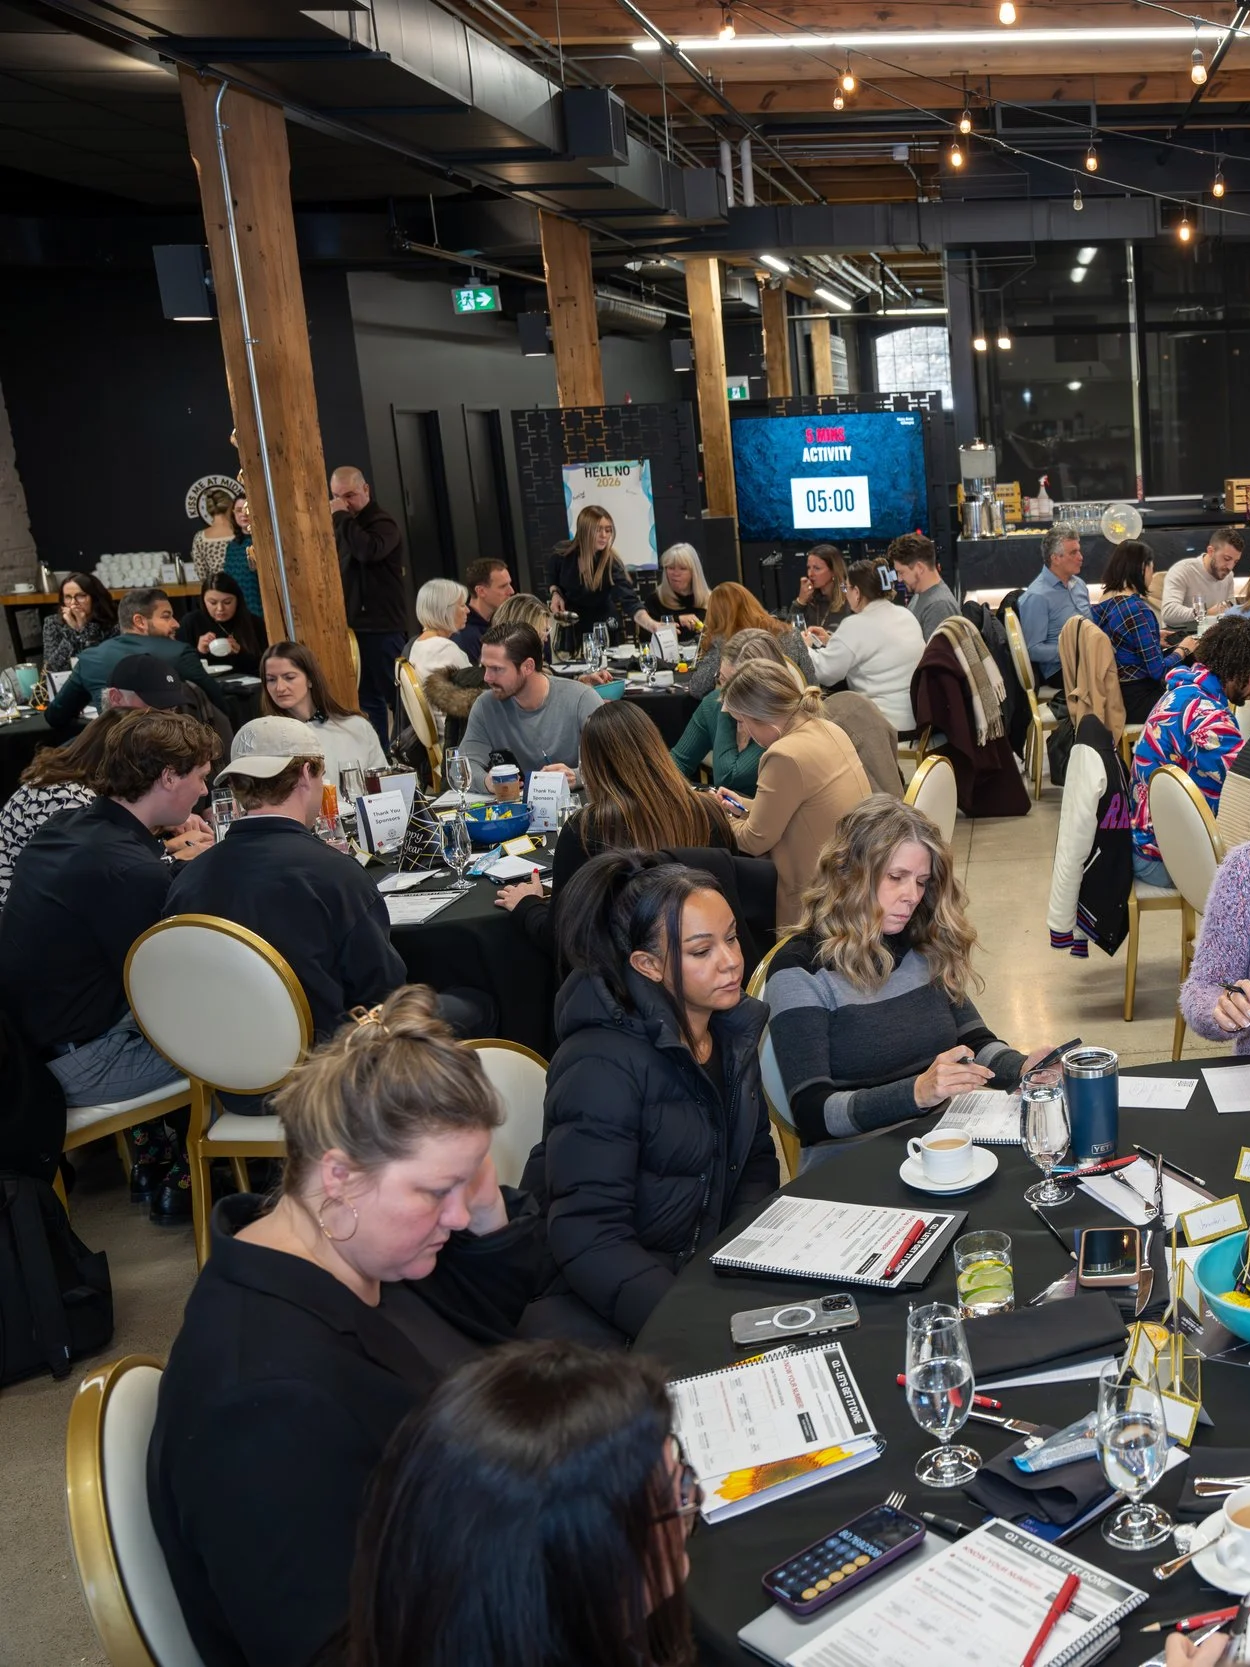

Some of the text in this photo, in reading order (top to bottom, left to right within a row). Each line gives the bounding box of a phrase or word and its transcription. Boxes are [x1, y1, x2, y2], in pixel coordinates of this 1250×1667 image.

[805, 427, 846, 443] 5 MINS
[802, 446, 852, 462] ACTIVITY
[584, 465, 630, 478] HELL NO
[596, 477, 621, 487] 2026
[188, 495, 196, 516] KISS
[192, 482, 205, 494] ME
[207, 477, 217, 485] AT
[806, 488, 855, 513] 05:00
[834, 1370, 850, 1388] LET'S
[840, 1385, 855, 1400] GET
[845, 1398, 857, 1407] IT
[848, 1405, 863, 1424] DONE
[1003, 1530, 1018, 1543] Q1
[1021, 1539, 1051, 1559] LET'S
[1047, 1553, 1069, 1569] GET
[1079, 1569, 1111, 1590] DONE
